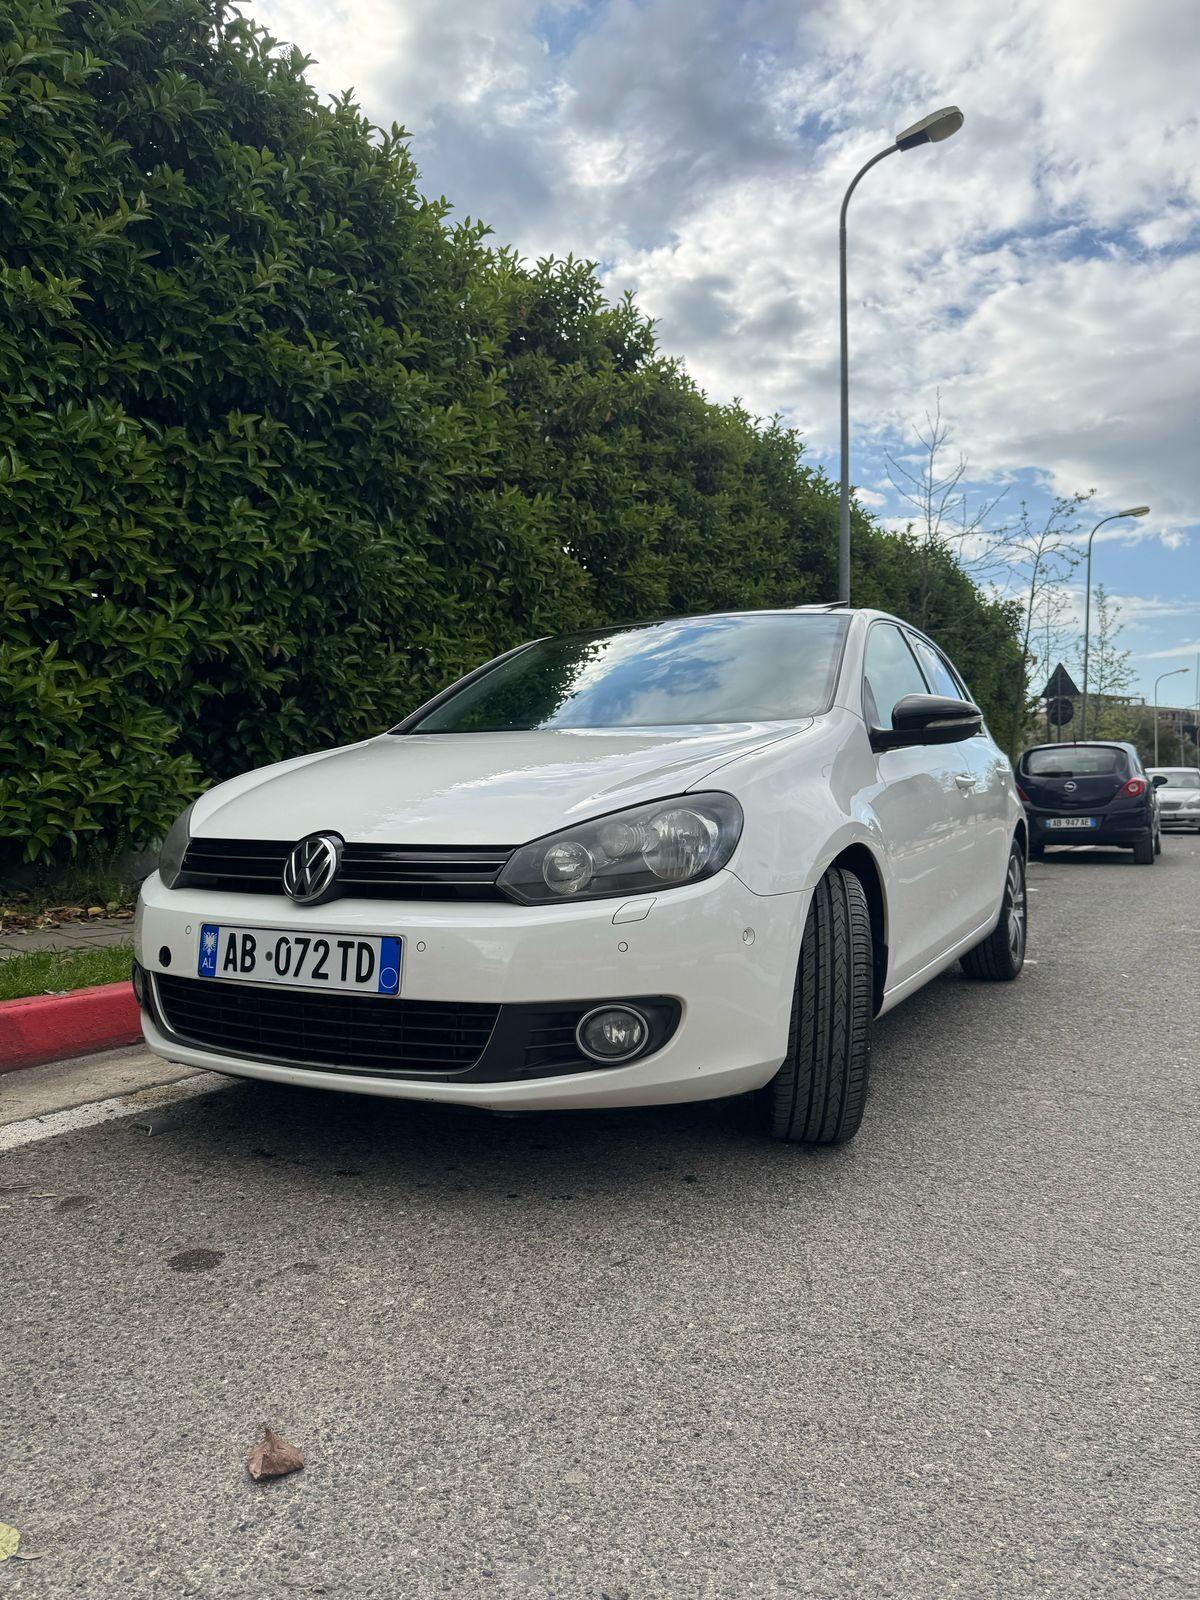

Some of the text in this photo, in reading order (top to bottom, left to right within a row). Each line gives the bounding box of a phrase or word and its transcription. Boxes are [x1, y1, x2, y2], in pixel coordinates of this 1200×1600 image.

[1052, 819, 1062, 827] AB
[201, 957, 214, 969] AL
[223, 932, 376, 983] AB 072 TD
